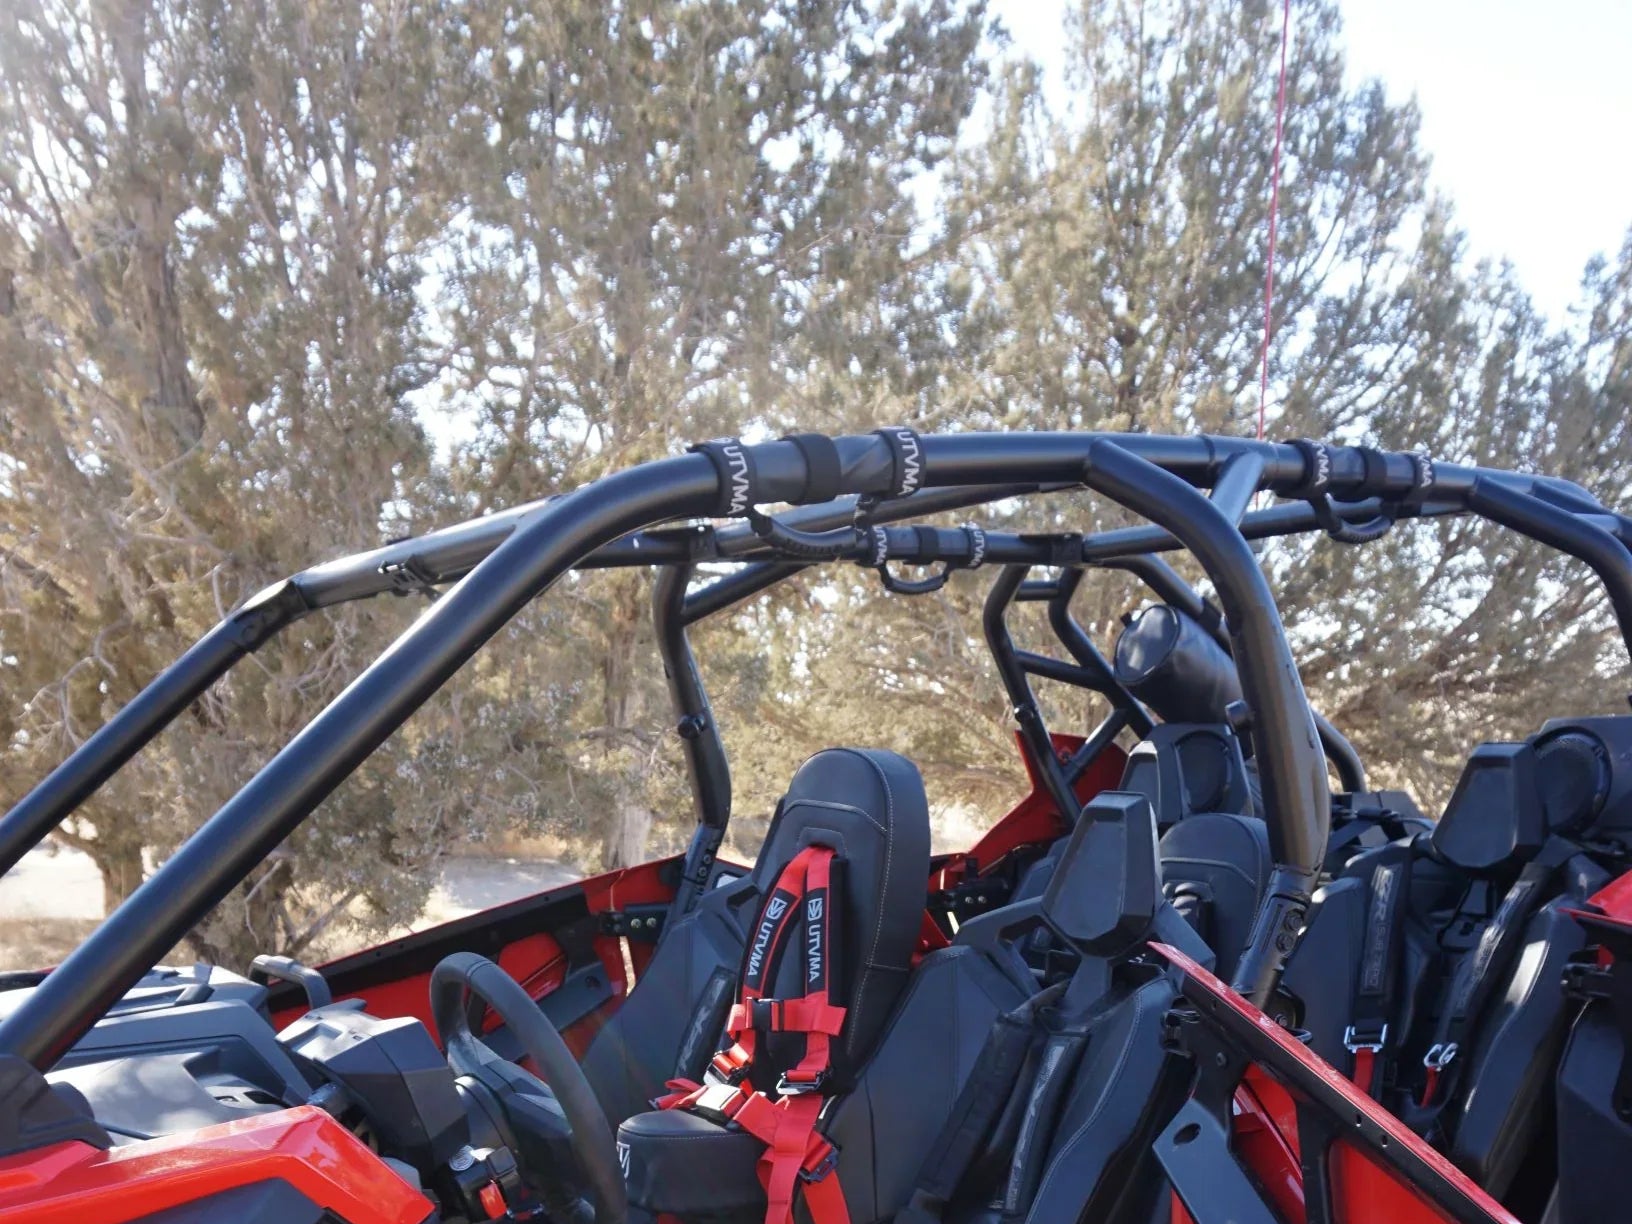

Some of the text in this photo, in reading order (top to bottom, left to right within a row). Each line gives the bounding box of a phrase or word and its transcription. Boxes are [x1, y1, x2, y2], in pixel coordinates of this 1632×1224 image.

[723, 445, 749, 514] UTVMA
[896, 432, 920, 495] UTVMA
[748, 921, 773, 976] UTVMA
[808, 924, 821, 982] UTVMA
